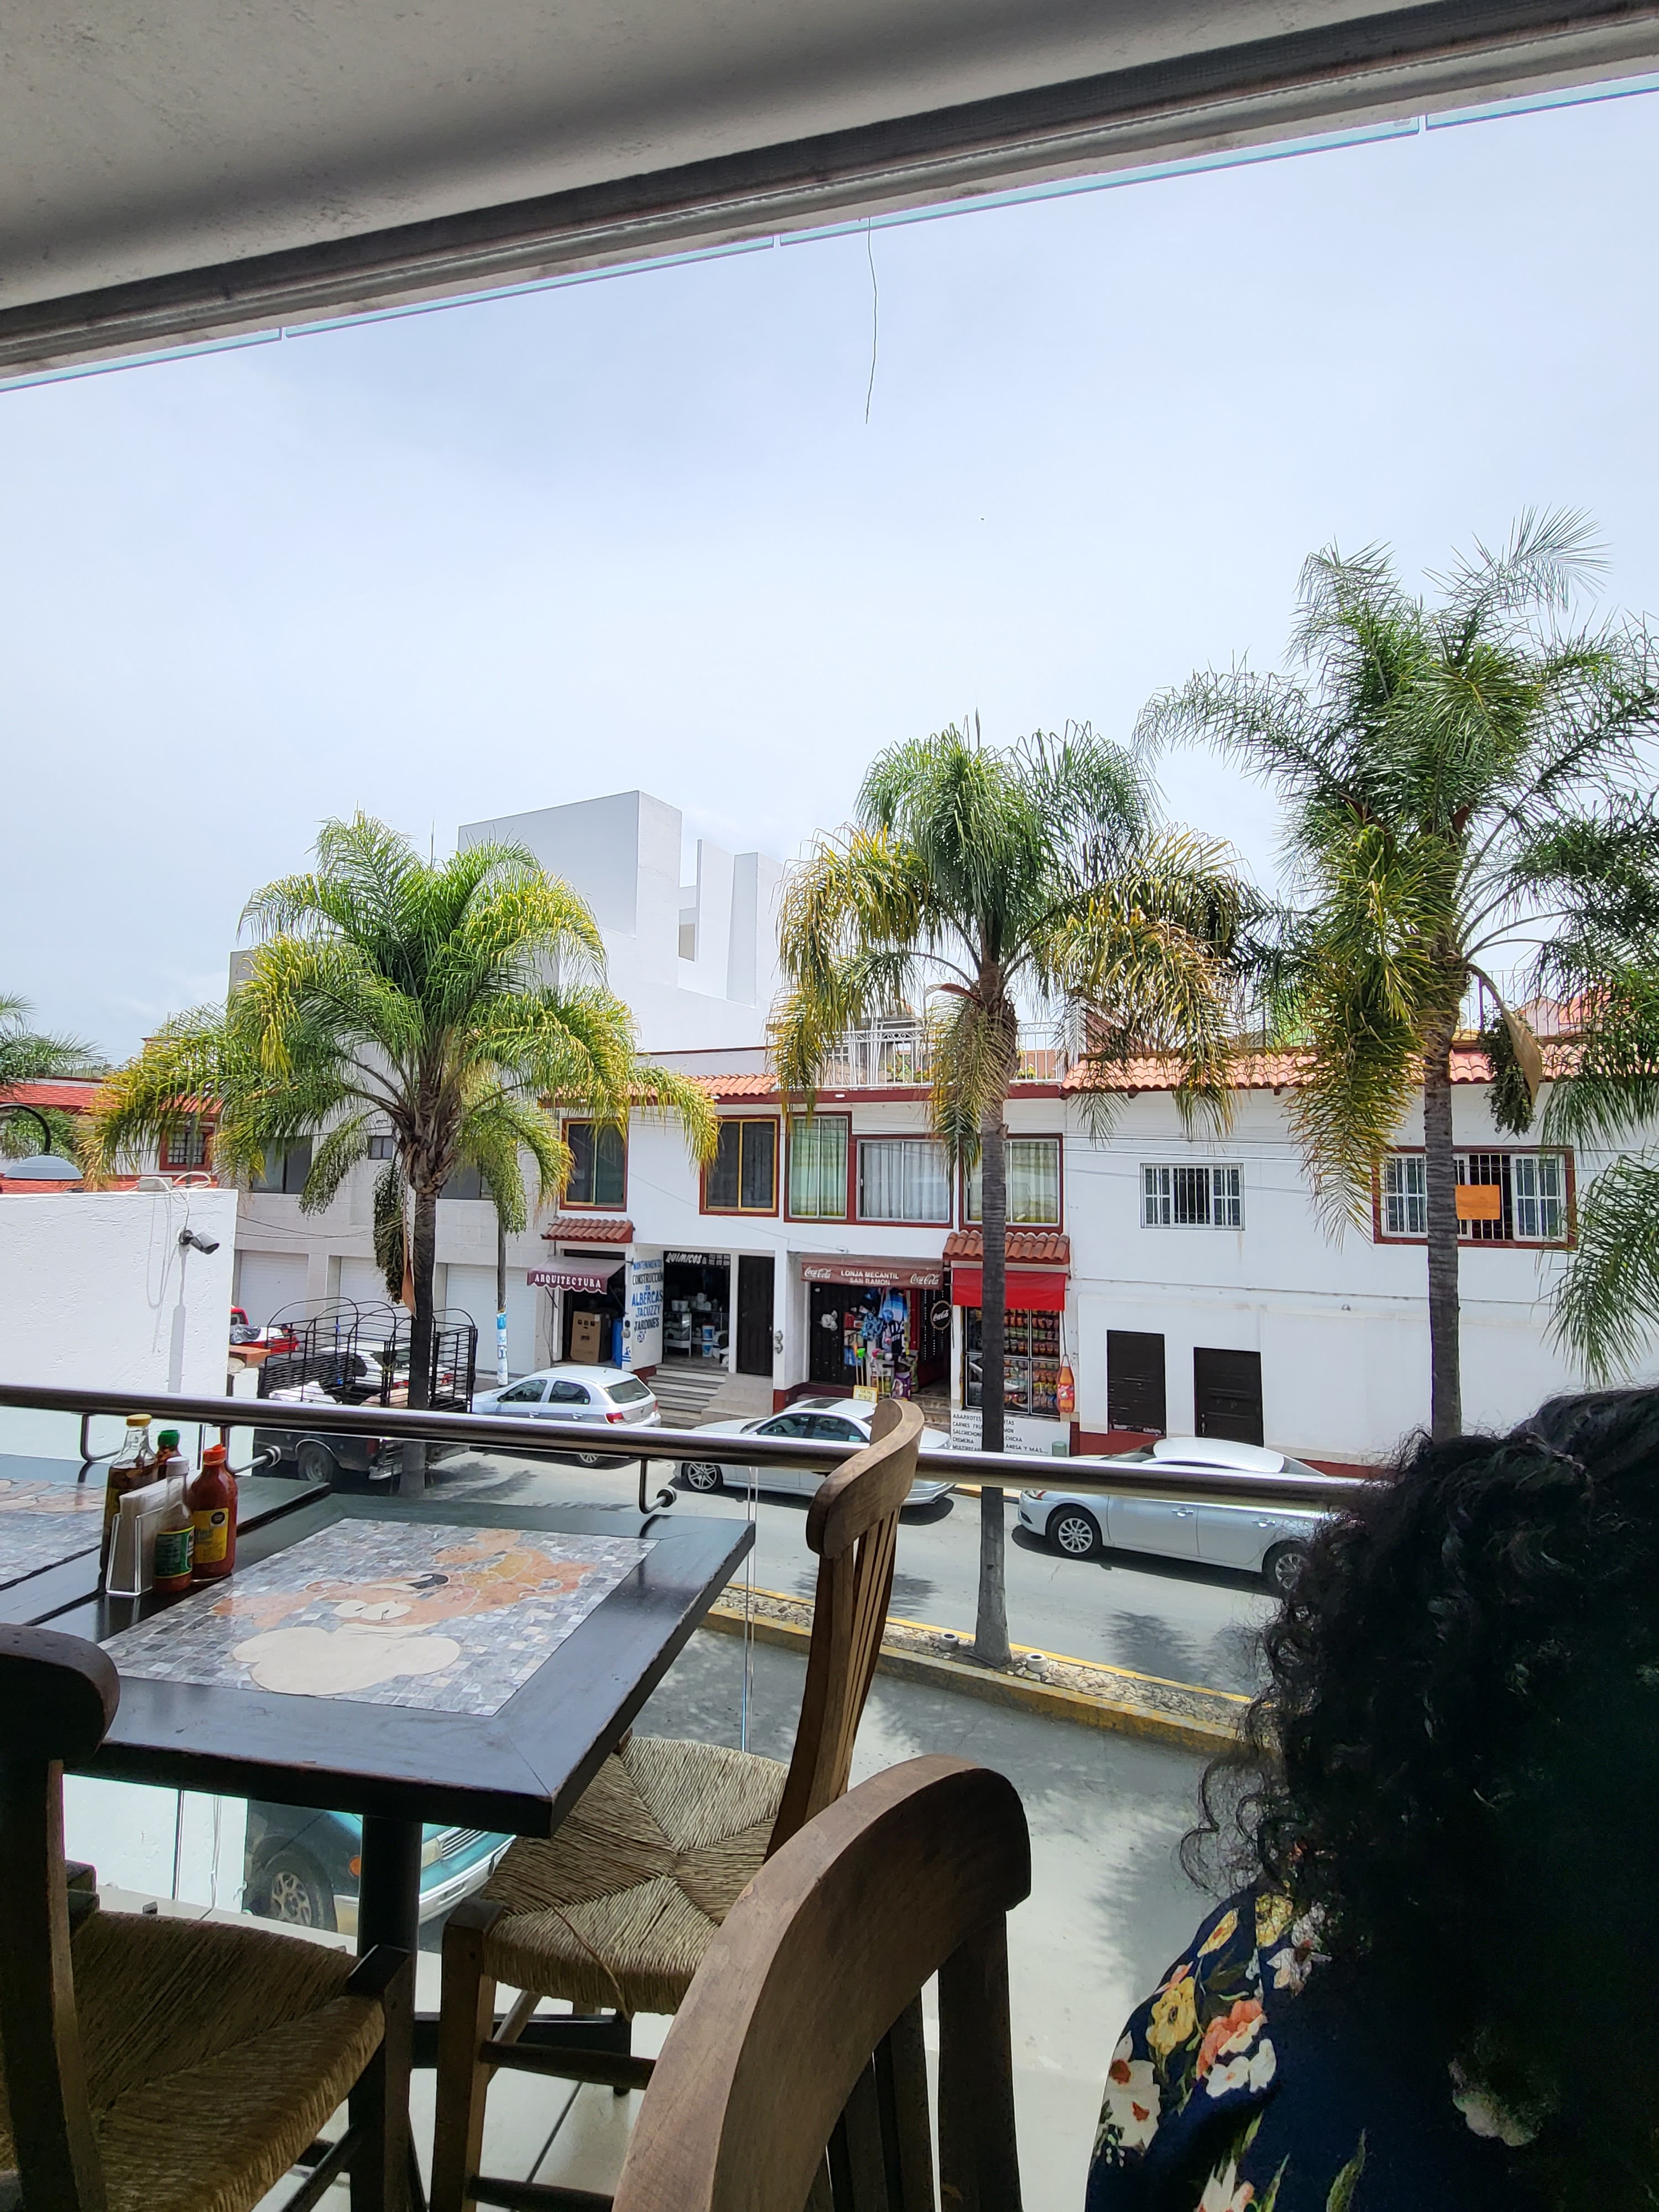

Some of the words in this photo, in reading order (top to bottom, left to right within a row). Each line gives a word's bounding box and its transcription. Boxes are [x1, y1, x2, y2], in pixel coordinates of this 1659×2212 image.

[665, 1252, 702, 1264] QUIMICOS
[535, 1274, 601, 1287] ARQUITECTURA
[632, 1290, 663, 1307] ALBERCAS
[636, 1305, 660, 1318] JACUZZY
